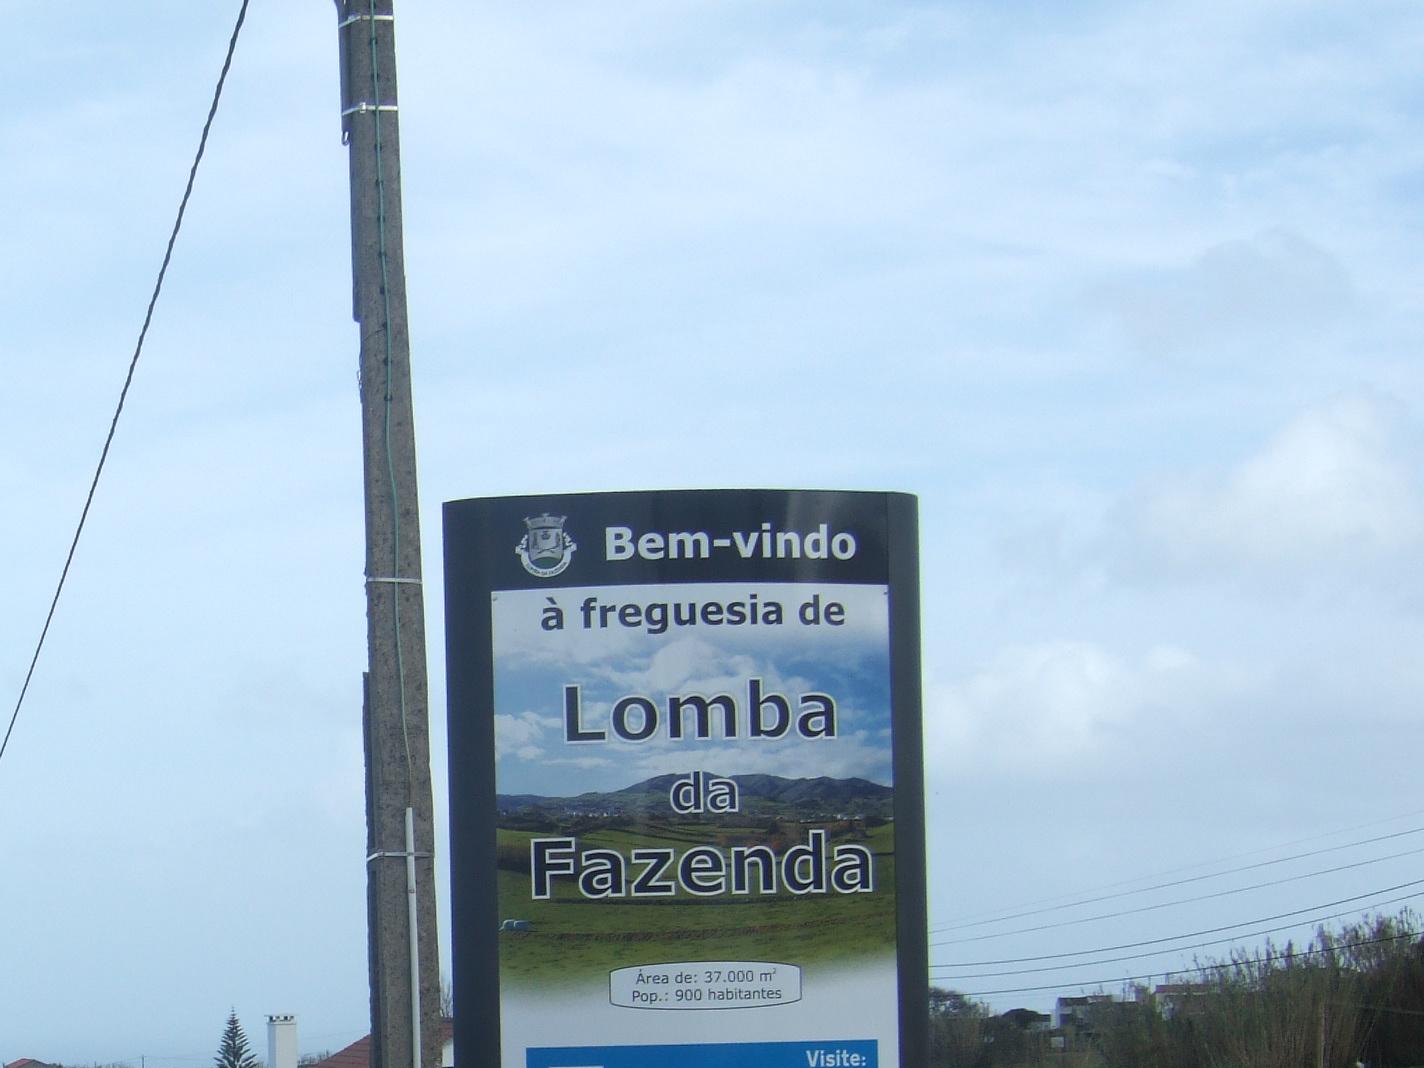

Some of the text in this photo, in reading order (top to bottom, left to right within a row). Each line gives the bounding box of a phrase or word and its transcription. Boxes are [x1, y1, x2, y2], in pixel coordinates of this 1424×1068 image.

[604, 523, 858, 561] Bem-vindo
[541, 594, 845, 633] à freguesia de
[563, 678, 838, 744] Lomba
[670, 770, 739, 813] da
[530, 829, 874, 899] Fazenda
[636, 969, 669, 984] Área
[675, 972, 698, 984] de:
[704, 970, 754, 983] 37.000
[632, 988, 782, 1004] Pop.: 900 habitantes
[806, 1050, 867, 1068] Visite:
